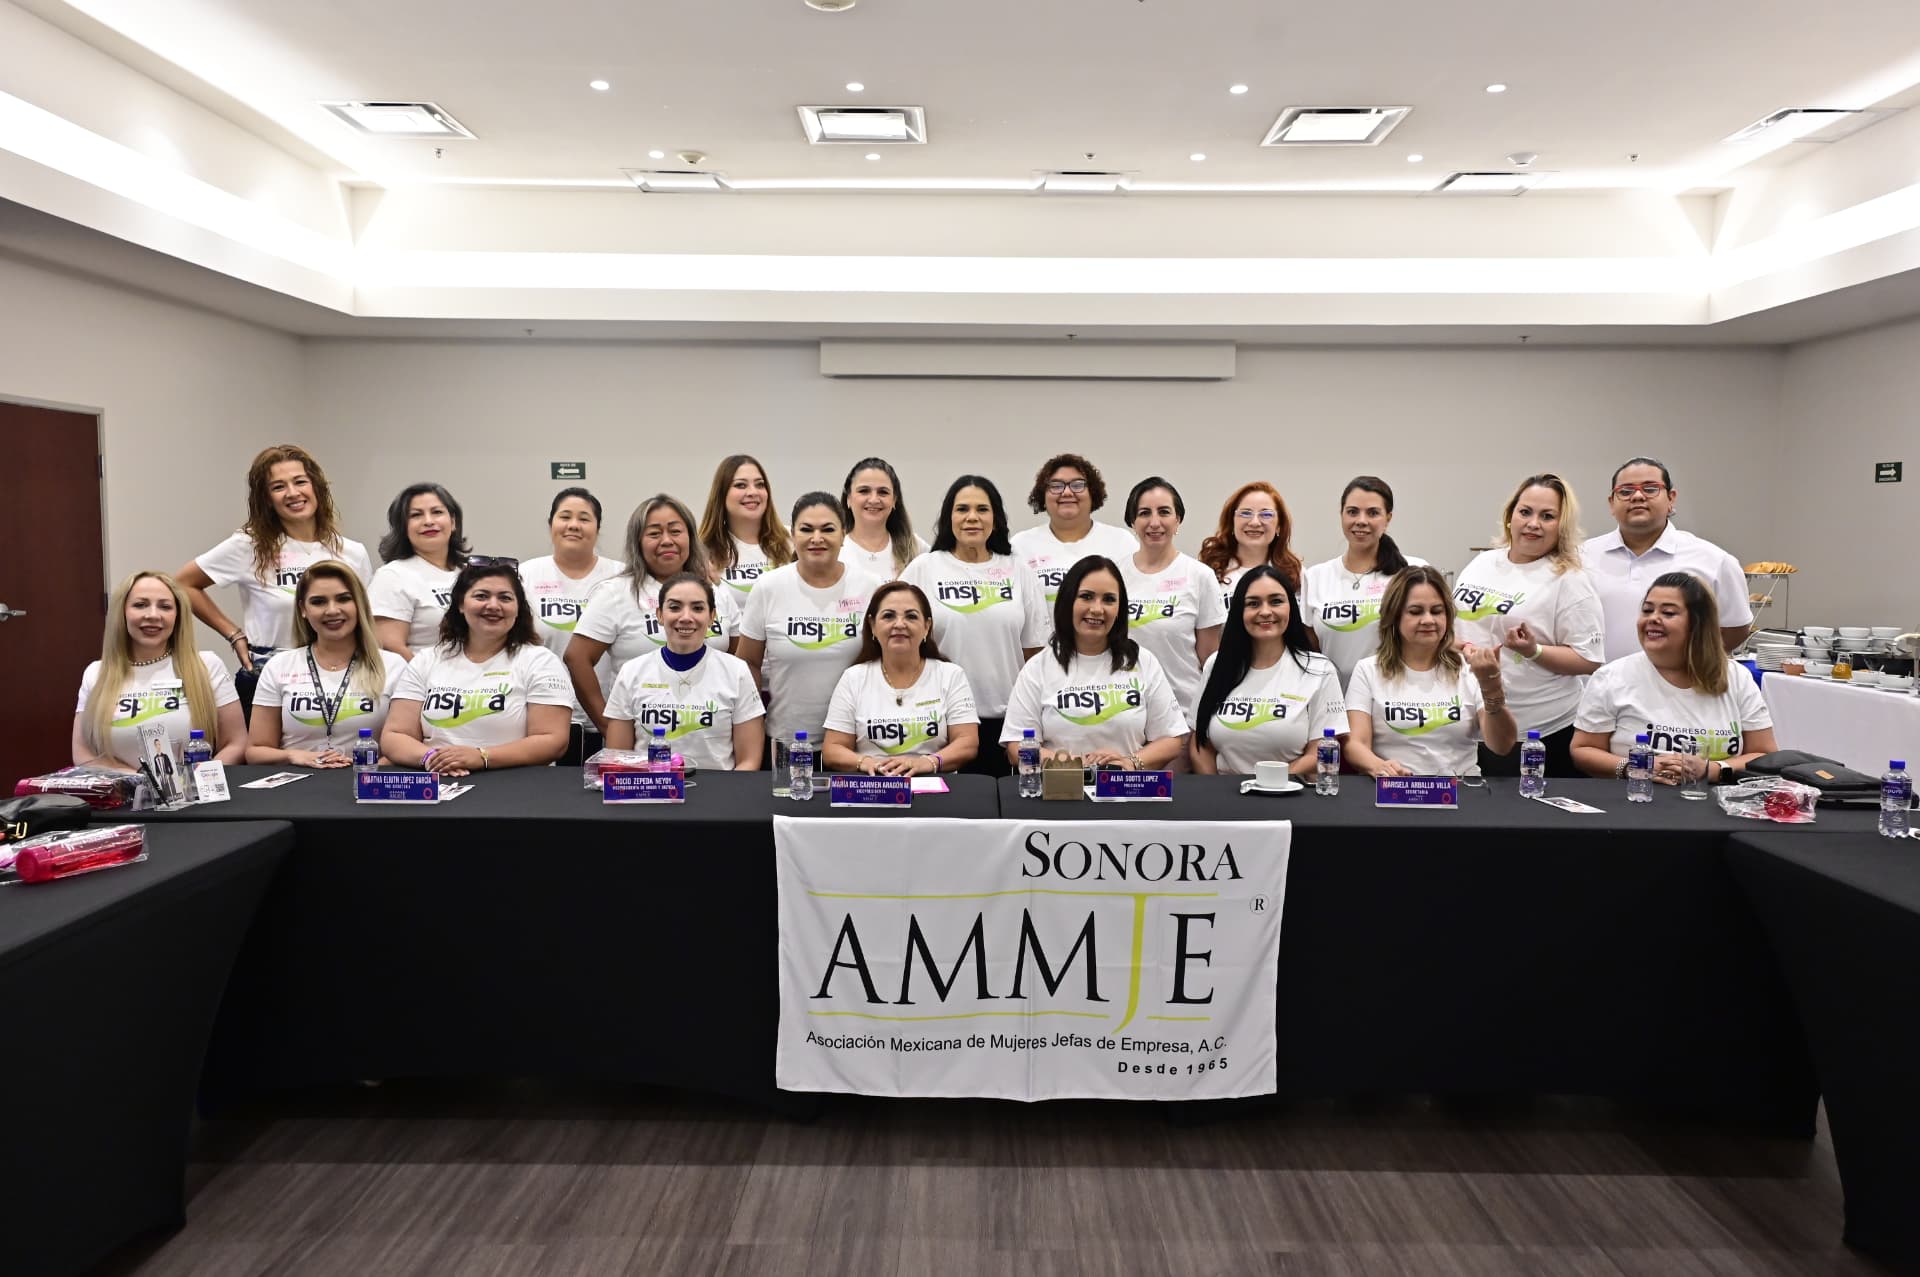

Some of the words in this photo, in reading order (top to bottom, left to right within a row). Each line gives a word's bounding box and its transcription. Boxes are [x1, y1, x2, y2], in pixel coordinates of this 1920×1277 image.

[937, 581, 1013, 605] inspira
[1127, 602, 1174, 621] spira
[787, 616, 857, 643] inspira
[118, 695, 180, 719] spira
[423, 688, 506, 719] inspira
[1057, 689, 1141, 716] inspira
[1384, 701, 1461, 729] inspira
[641, 703, 713, 732] inspira
[1655, 724, 1707, 735] CONGRESO
[867, 719, 939, 746] inspira
[849, 780, 859, 788] DEL
[809, 893, 1216, 1035] AMMJE
[806, 1031, 885, 1049] Asociación
[890, 1037, 961, 1052] Mexicana
[966, 1034, 985, 1048] de
[990, 1034, 1047, 1052] Mujeres
[1051, 1033, 1092, 1048] Jefas
[1096, 1036, 1116, 1050] de
[1121, 1037, 1194, 1055] Empresa,
[1198, 1036, 1228, 1053] A.C.
[1117, 1061, 1178, 1075] Desde
[1186, 1057, 1228, 1075] 1965
